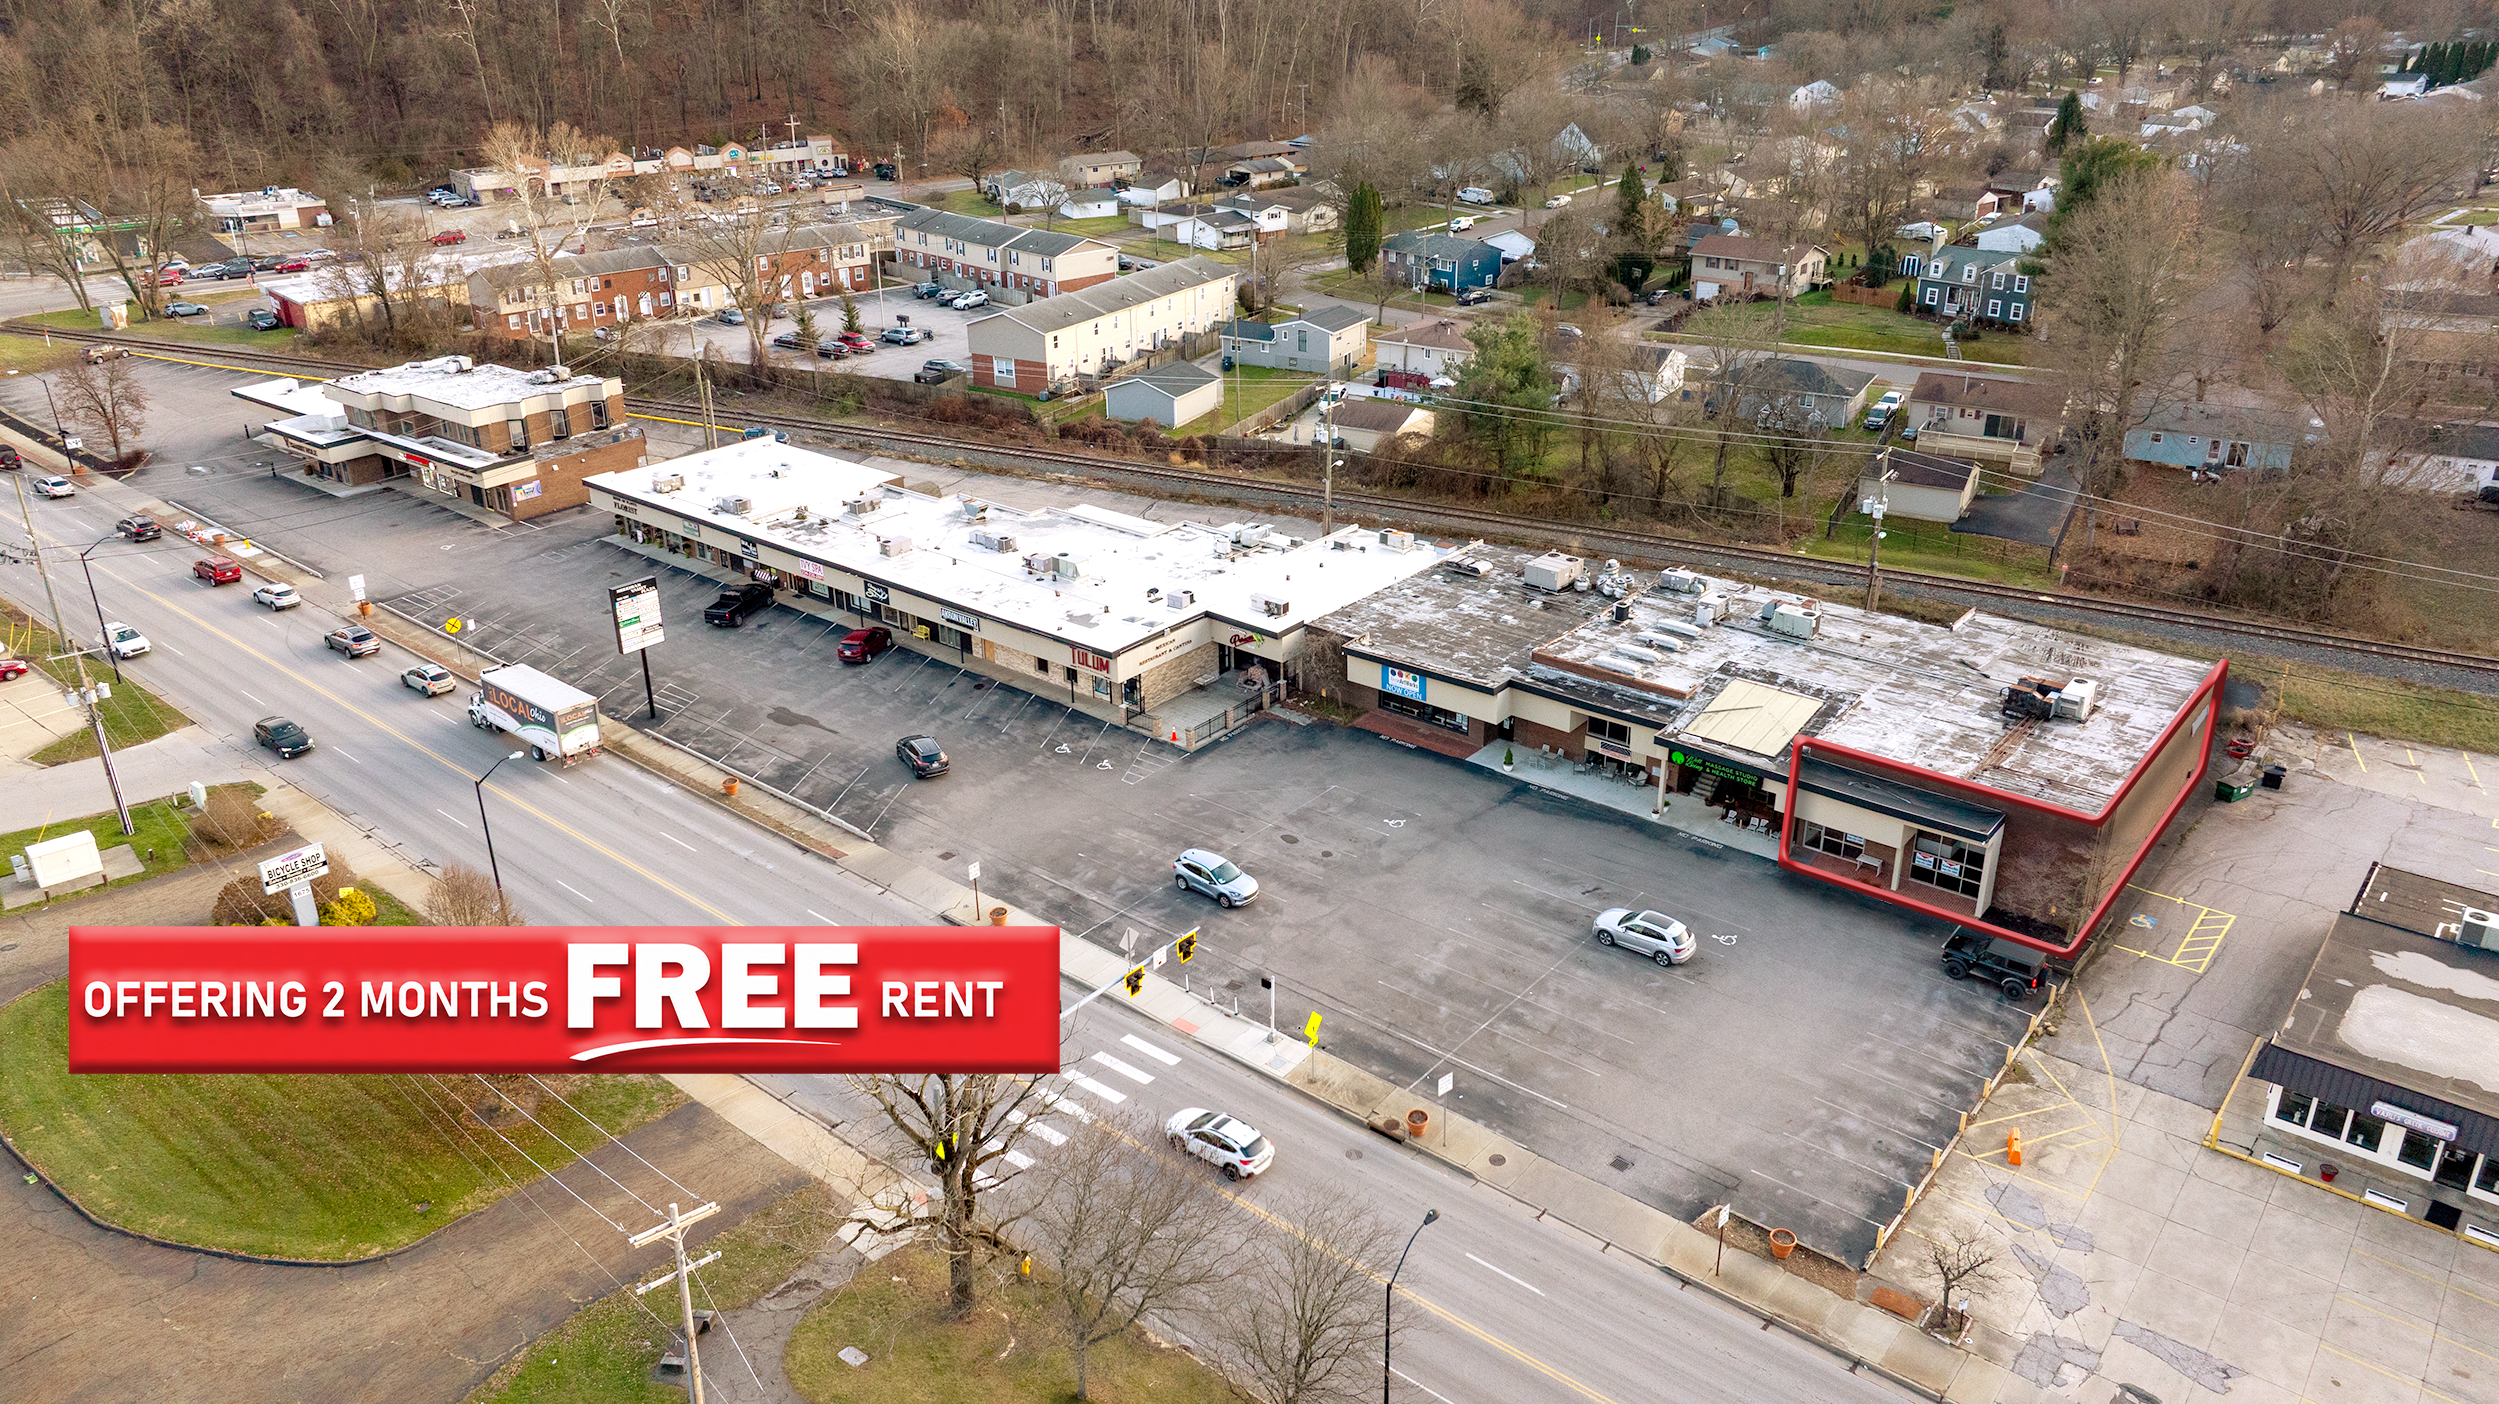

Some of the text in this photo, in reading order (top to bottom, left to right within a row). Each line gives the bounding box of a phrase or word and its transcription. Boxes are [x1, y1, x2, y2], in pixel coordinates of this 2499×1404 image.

[614, 501, 638, 515] FLORIST
[1069, 646, 1109, 674] TULUM
[1386, 684, 1422, 700] NOW OPEN
[492, 687, 535, 722] LOCAL
[1705, 761, 1758, 781] MASSAGE STUDIO
[1711, 769, 1735, 780] HEALTH
[1736, 776, 1757, 787] STORE
[1690, 836, 1724, 849] PARKING
[267, 861, 300, 879] BICYCLE
[300, 853, 321, 867] SHOP
[2403, 1118, 2423, 1130] GREEK
[2426, 1125, 2452, 1139] CUISINE
